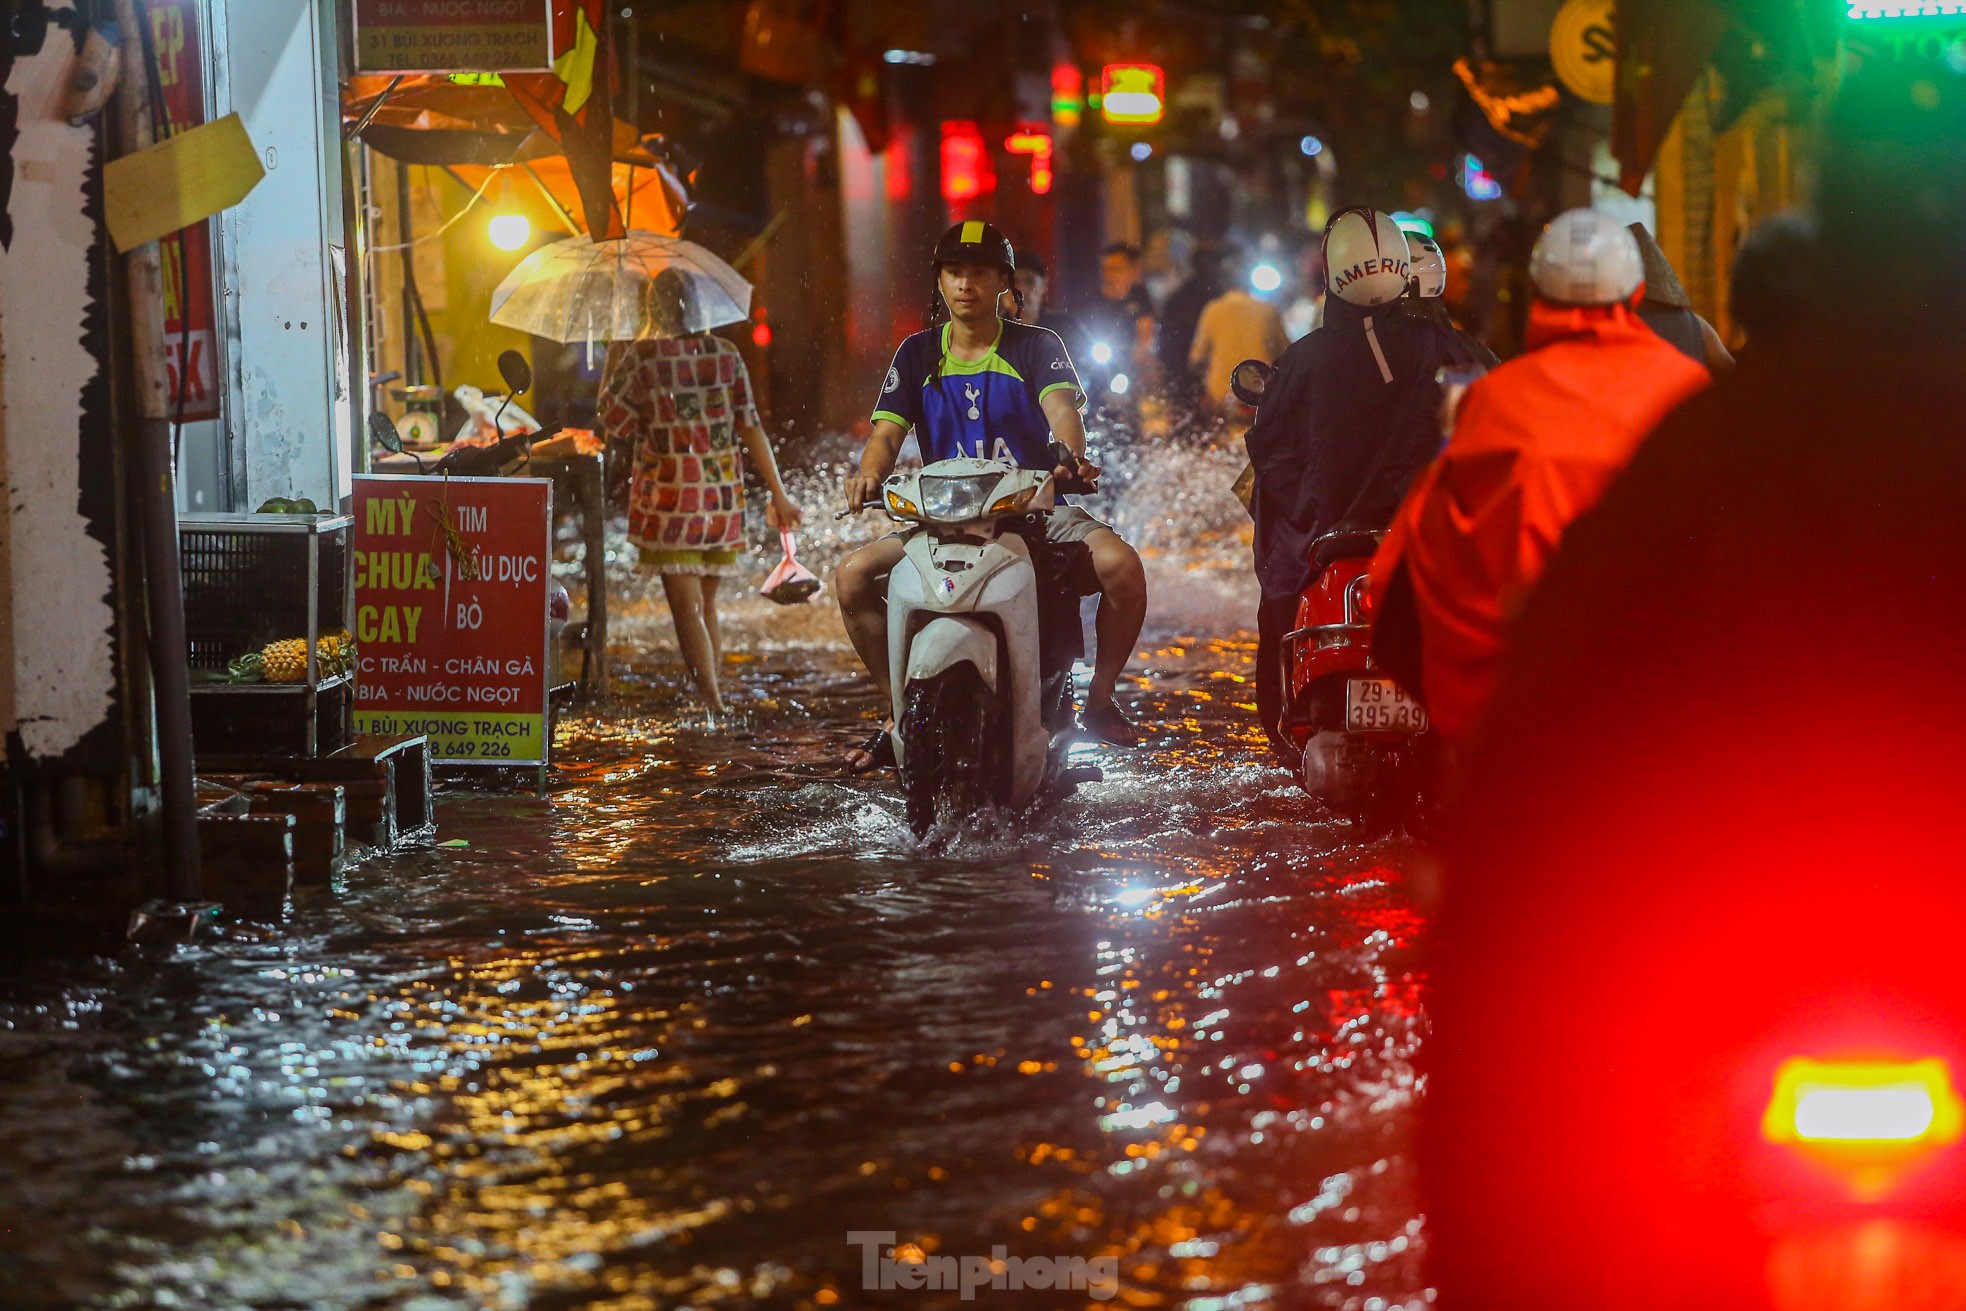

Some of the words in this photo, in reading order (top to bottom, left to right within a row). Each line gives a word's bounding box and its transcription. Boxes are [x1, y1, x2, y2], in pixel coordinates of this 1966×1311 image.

[370, 34, 387, 49] 31
[366, 490, 417, 536] MỲ
[457, 505, 487, 532] TIM
[354, 550, 436, 590] CHUA
[498, 554, 537, 588] DỤC
[357, 604, 422, 644] CAY
[456, 594, 483, 630] BÒ
[380, 652, 427, 674] TRẦN
[445, 655, 500, 675] CHÂN
[505, 655, 535, 676] GÀ
[359, 685, 388, 700] BIA
[407, 681, 461, 702] NƯỚC
[467, 687, 521, 706] NGỌT
[371, 715, 397, 734] BÙI
[403, 719, 468, 736] XƯƠNG
[473, 721, 531, 739] TRẠCH
[445, 741, 476, 756] 649
[480, 741, 511, 757] 226
